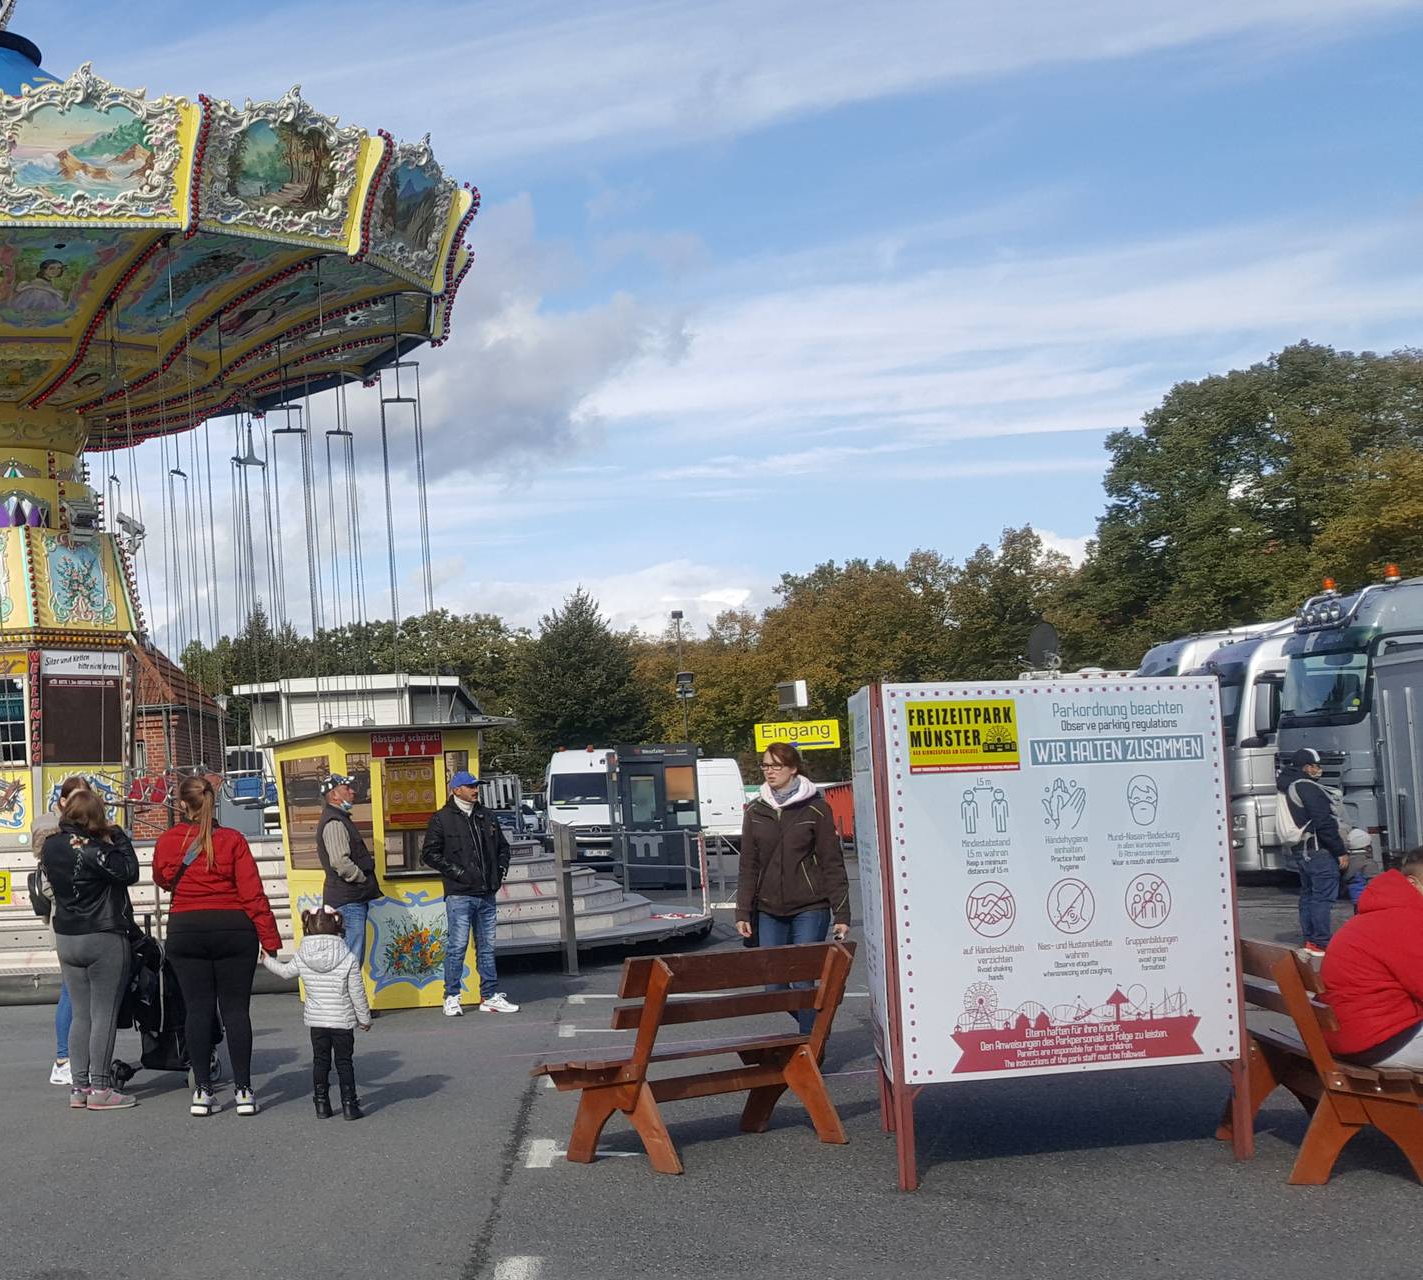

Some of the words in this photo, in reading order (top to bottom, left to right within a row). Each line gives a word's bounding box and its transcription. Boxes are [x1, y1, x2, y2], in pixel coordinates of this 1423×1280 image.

[29, 650, 41, 762] WELLENFLUG
[1052, 702, 1127, 719] Parkordnung
[1130, 700, 1183, 715] beachten
[908, 706, 1012, 726] FREIZEITPARK
[1061, 720, 1096, 731] Observe
[1098, 720, 1130, 733] parking
[1131, 718, 1177, 732] regulations
[761, 724, 830, 740] Eingang
[910, 728, 981, 748] MÜNSTER
[372, 735, 405, 743] Abstand
[1035, 742, 1066, 763] WIR
[1070, 740, 1122, 761] HALTEN
[1125, 738, 1202, 760] ZUSAMMEN
[961, 839, 1010, 847] Mindestabstand
[1056, 941, 1067, 949] und
[1125, 935, 1178, 947] Gruppenbildungen
[963, 946, 973, 955] auf
[1065, 951, 1089, 959] wahren
[1137, 946, 1168, 954] vermeiden
[977, 956, 1013, 964] verzichten
[1090, 967, 1112, 975] coughing
[1025, 1028, 1046, 1038] Eltern
[1047, 1026, 1070, 1036] haften
[1072, 1025, 1083, 1034] für
[1084, 1024, 1097, 1033] ihre
[980, 1042, 994, 1051] Den
[995, 1039, 1041, 1050] Anweisungen
[1042, 1037, 1054, 1046] des
[1056, 1034, 1104, 1046] Parkpersonals
[1105, 1033, 1114, 1041] ist
[1115, 1032, 1133, 1042] Folge
[1017, 1049, 1039, 1057] Parents
[1051, 1046, 1083, 1055] responsible
[1016, 1058, 1049, 1066] instructions
[1057, 1055, 1067, 1063] the
[1068, 1054, 1081, 1063] park
[1083, 1053, 1097, 1061] staff
